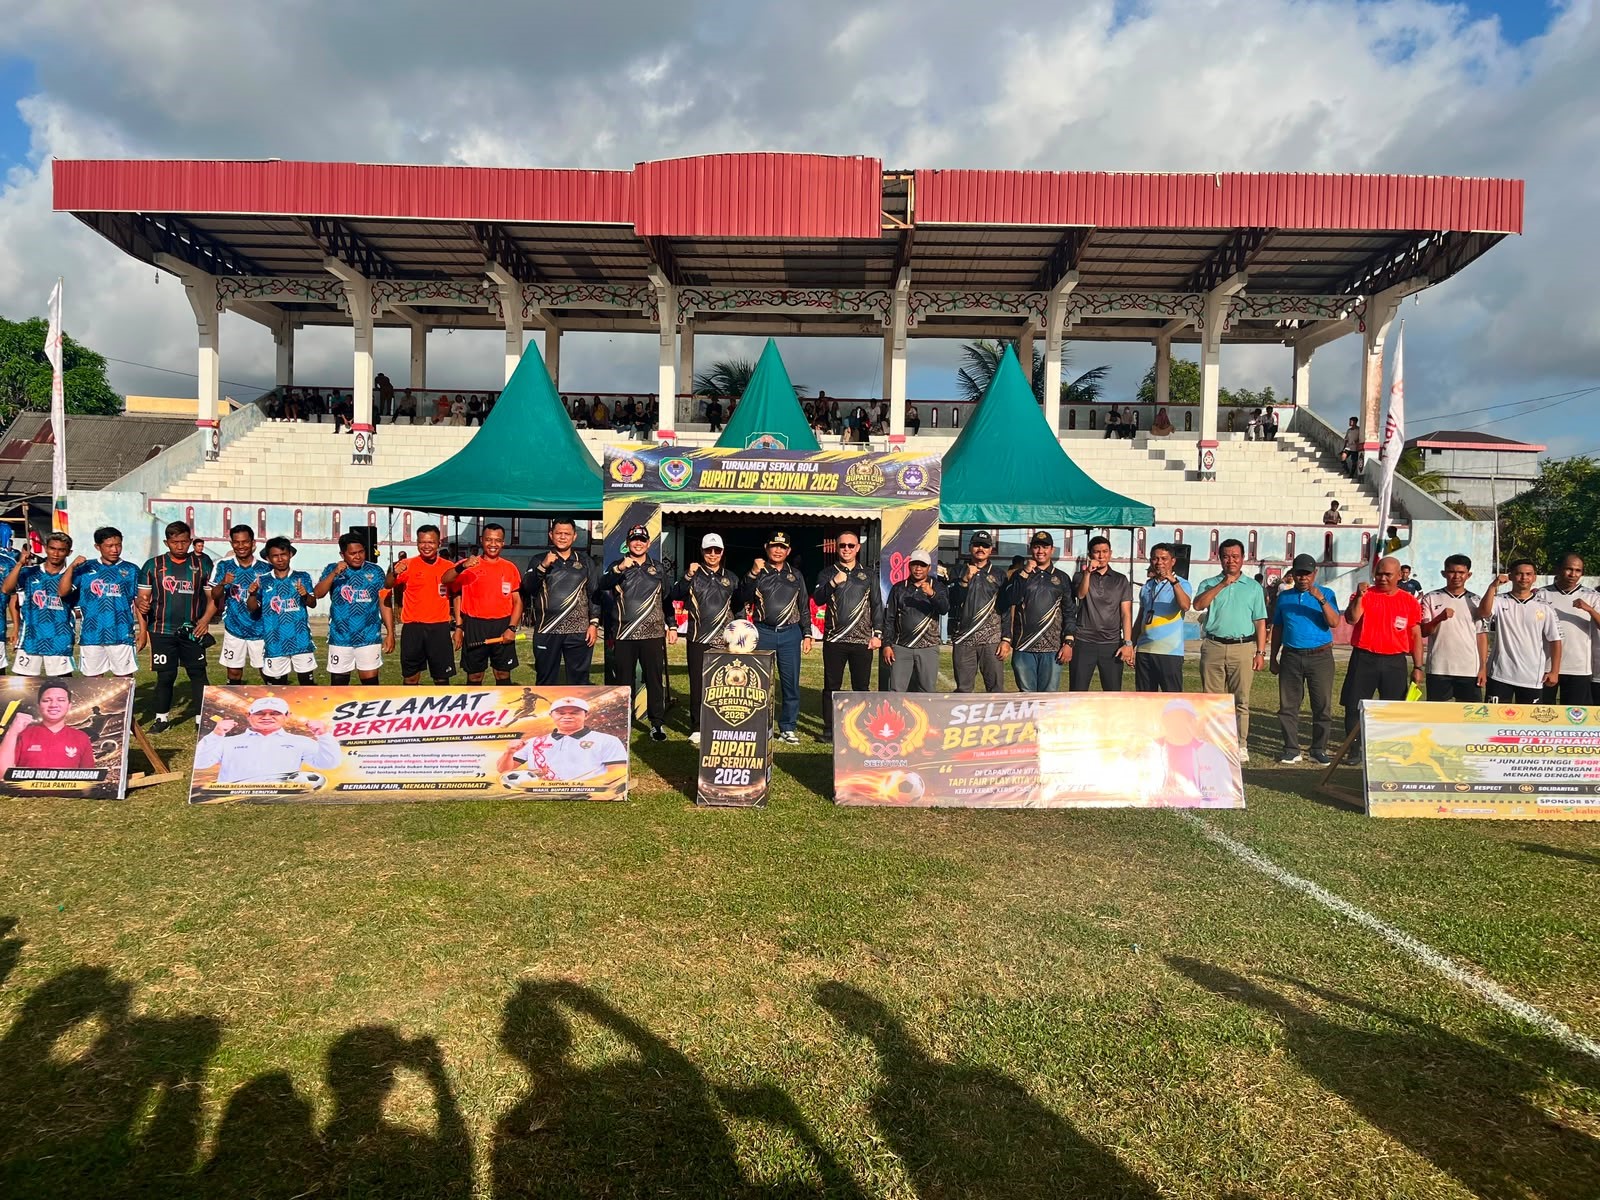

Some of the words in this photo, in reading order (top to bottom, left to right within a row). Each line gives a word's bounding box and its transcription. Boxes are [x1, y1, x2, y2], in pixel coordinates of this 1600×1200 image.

[721, 460, 766, 470] TURNAMEN
[768, 462, 796, 472] SEPAK
[798, 462, 819, 472] BOLA
[699, 470, 737, 488] BUPATI
[738, 470, 760, 489] CUP
[760, 471, 810, 490] SERUYAN
[810, 473, 839, 491] 2026
[846, 474, 870, 483] BUPATI
[870, 474, 884, 484] CUP
[154, 654, 167, 664] 20
[223, 648, 234, 660] 23
[330, 654, 340, 664] 19
[18, 656, 30, 667] 27
[268, 658, 272, 668] 8
[706, 686, 744, 702] BUPATI
[746, 686, 765, 703] CUP
[332, 692, 490, 720] SELAMAT
[718, 698, 753, 707] SERUYAN
[948, 700, 1041, 725] SELAM
[332, 709, 509, 737] BERTANDING!
[712, 730, 757, 741] TURNAMEN
[942, 721, 1038, 750] BERTA
[710, 740, 757, 757] BUPATI
[1466, 744, 1519, 753] BUPATI
[1522, 745, 1554, 753] CUP
[1556, 746, 1600, 754] SERUY
[702, 756, 721, 768] CUP
[722, 756, 764, 770] SERUYAN
[11, 770, 35, 779] FALDO
[58, 770, 100, 780] RAMADHAN
[714, 768, 750, 785] 2026
[948, 778, 968, 787] TAPI
[968, 777, 988, 786] FAIR
[990, 776, 1011, 786] PLAY
